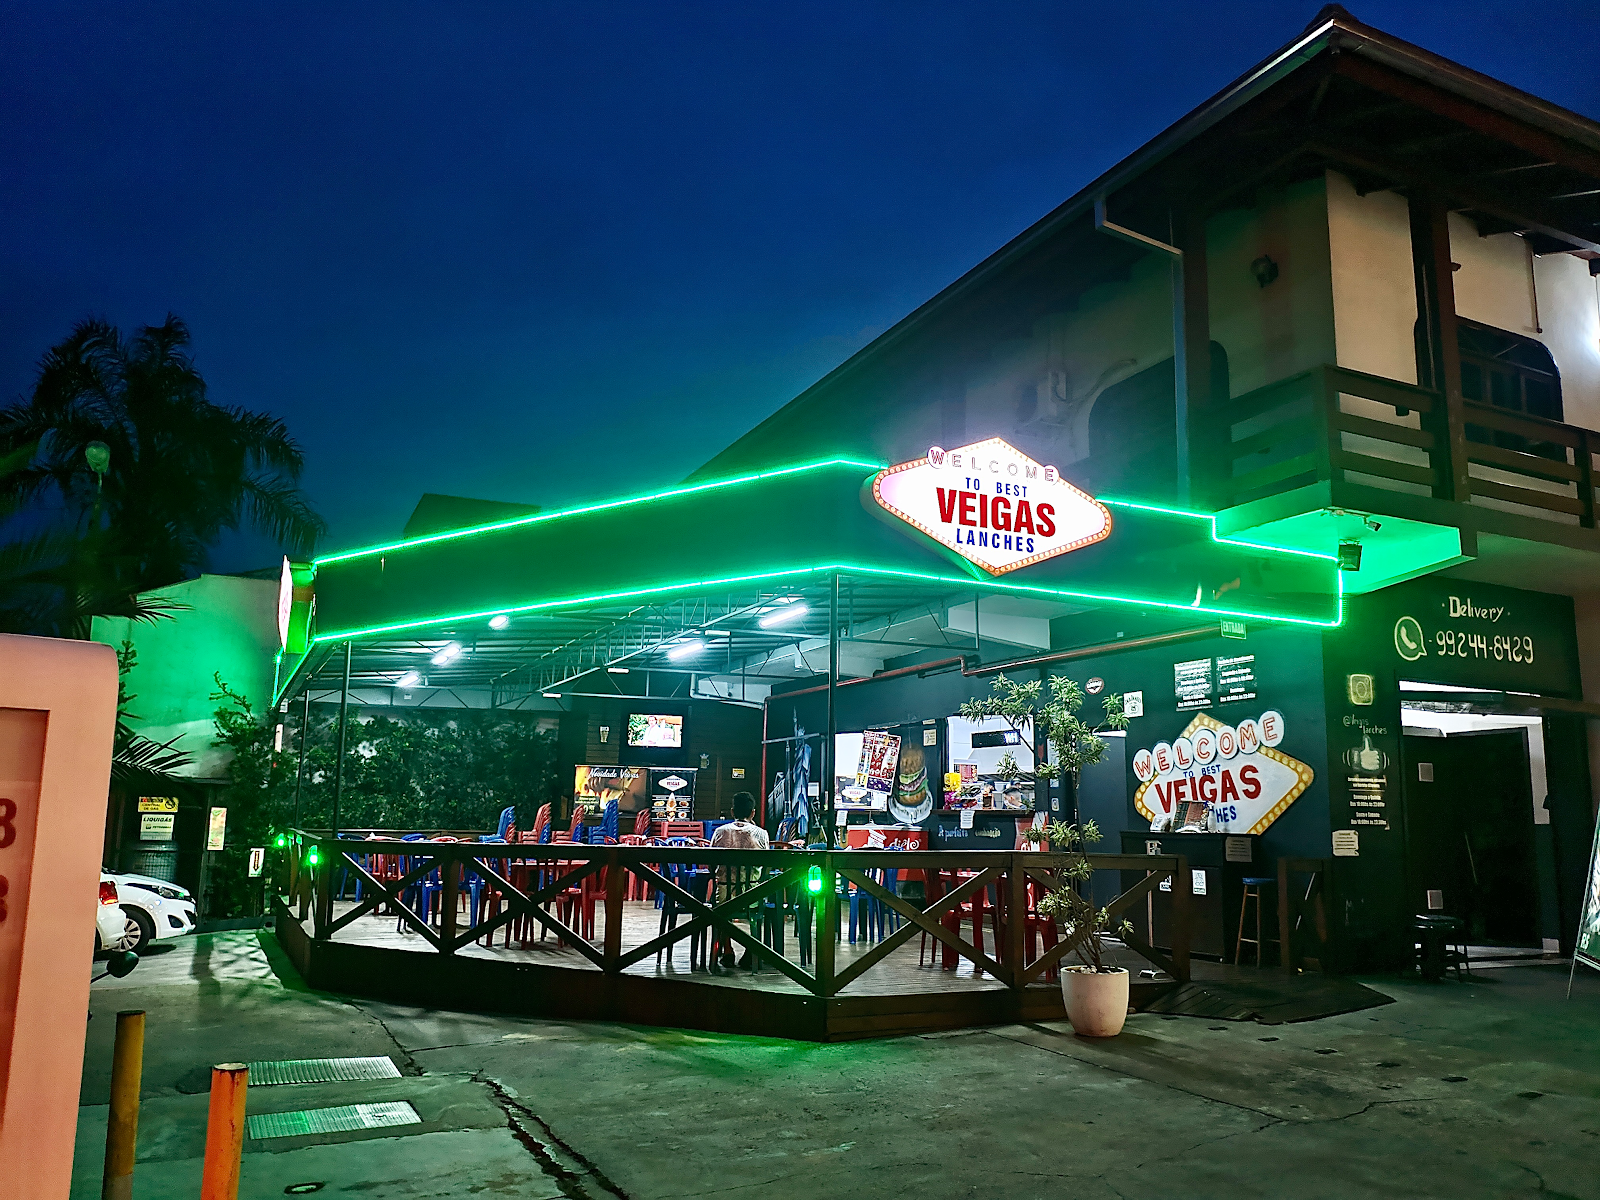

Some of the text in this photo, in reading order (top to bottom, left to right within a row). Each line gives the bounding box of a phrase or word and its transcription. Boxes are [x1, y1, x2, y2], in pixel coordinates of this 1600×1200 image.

[931, 449, 1054, 482] WELCOME
[965, 477, 1028, 498] TO BEST
[936, 487, 1056, 537] VEIGAS
[956, 528, 1035, 553] LANCHES
[1449, 596, 1504, 622] Delivery
[1222, 620, 1245, 635] ENTRADA
[1436, 630, 1534, 664] 99244-8429
[1134, 716, 1278, 779] WELCOME
[1183, 764, 1221, 778] TO BEST
[1155, 765, 1262, 814] VEIGAS
